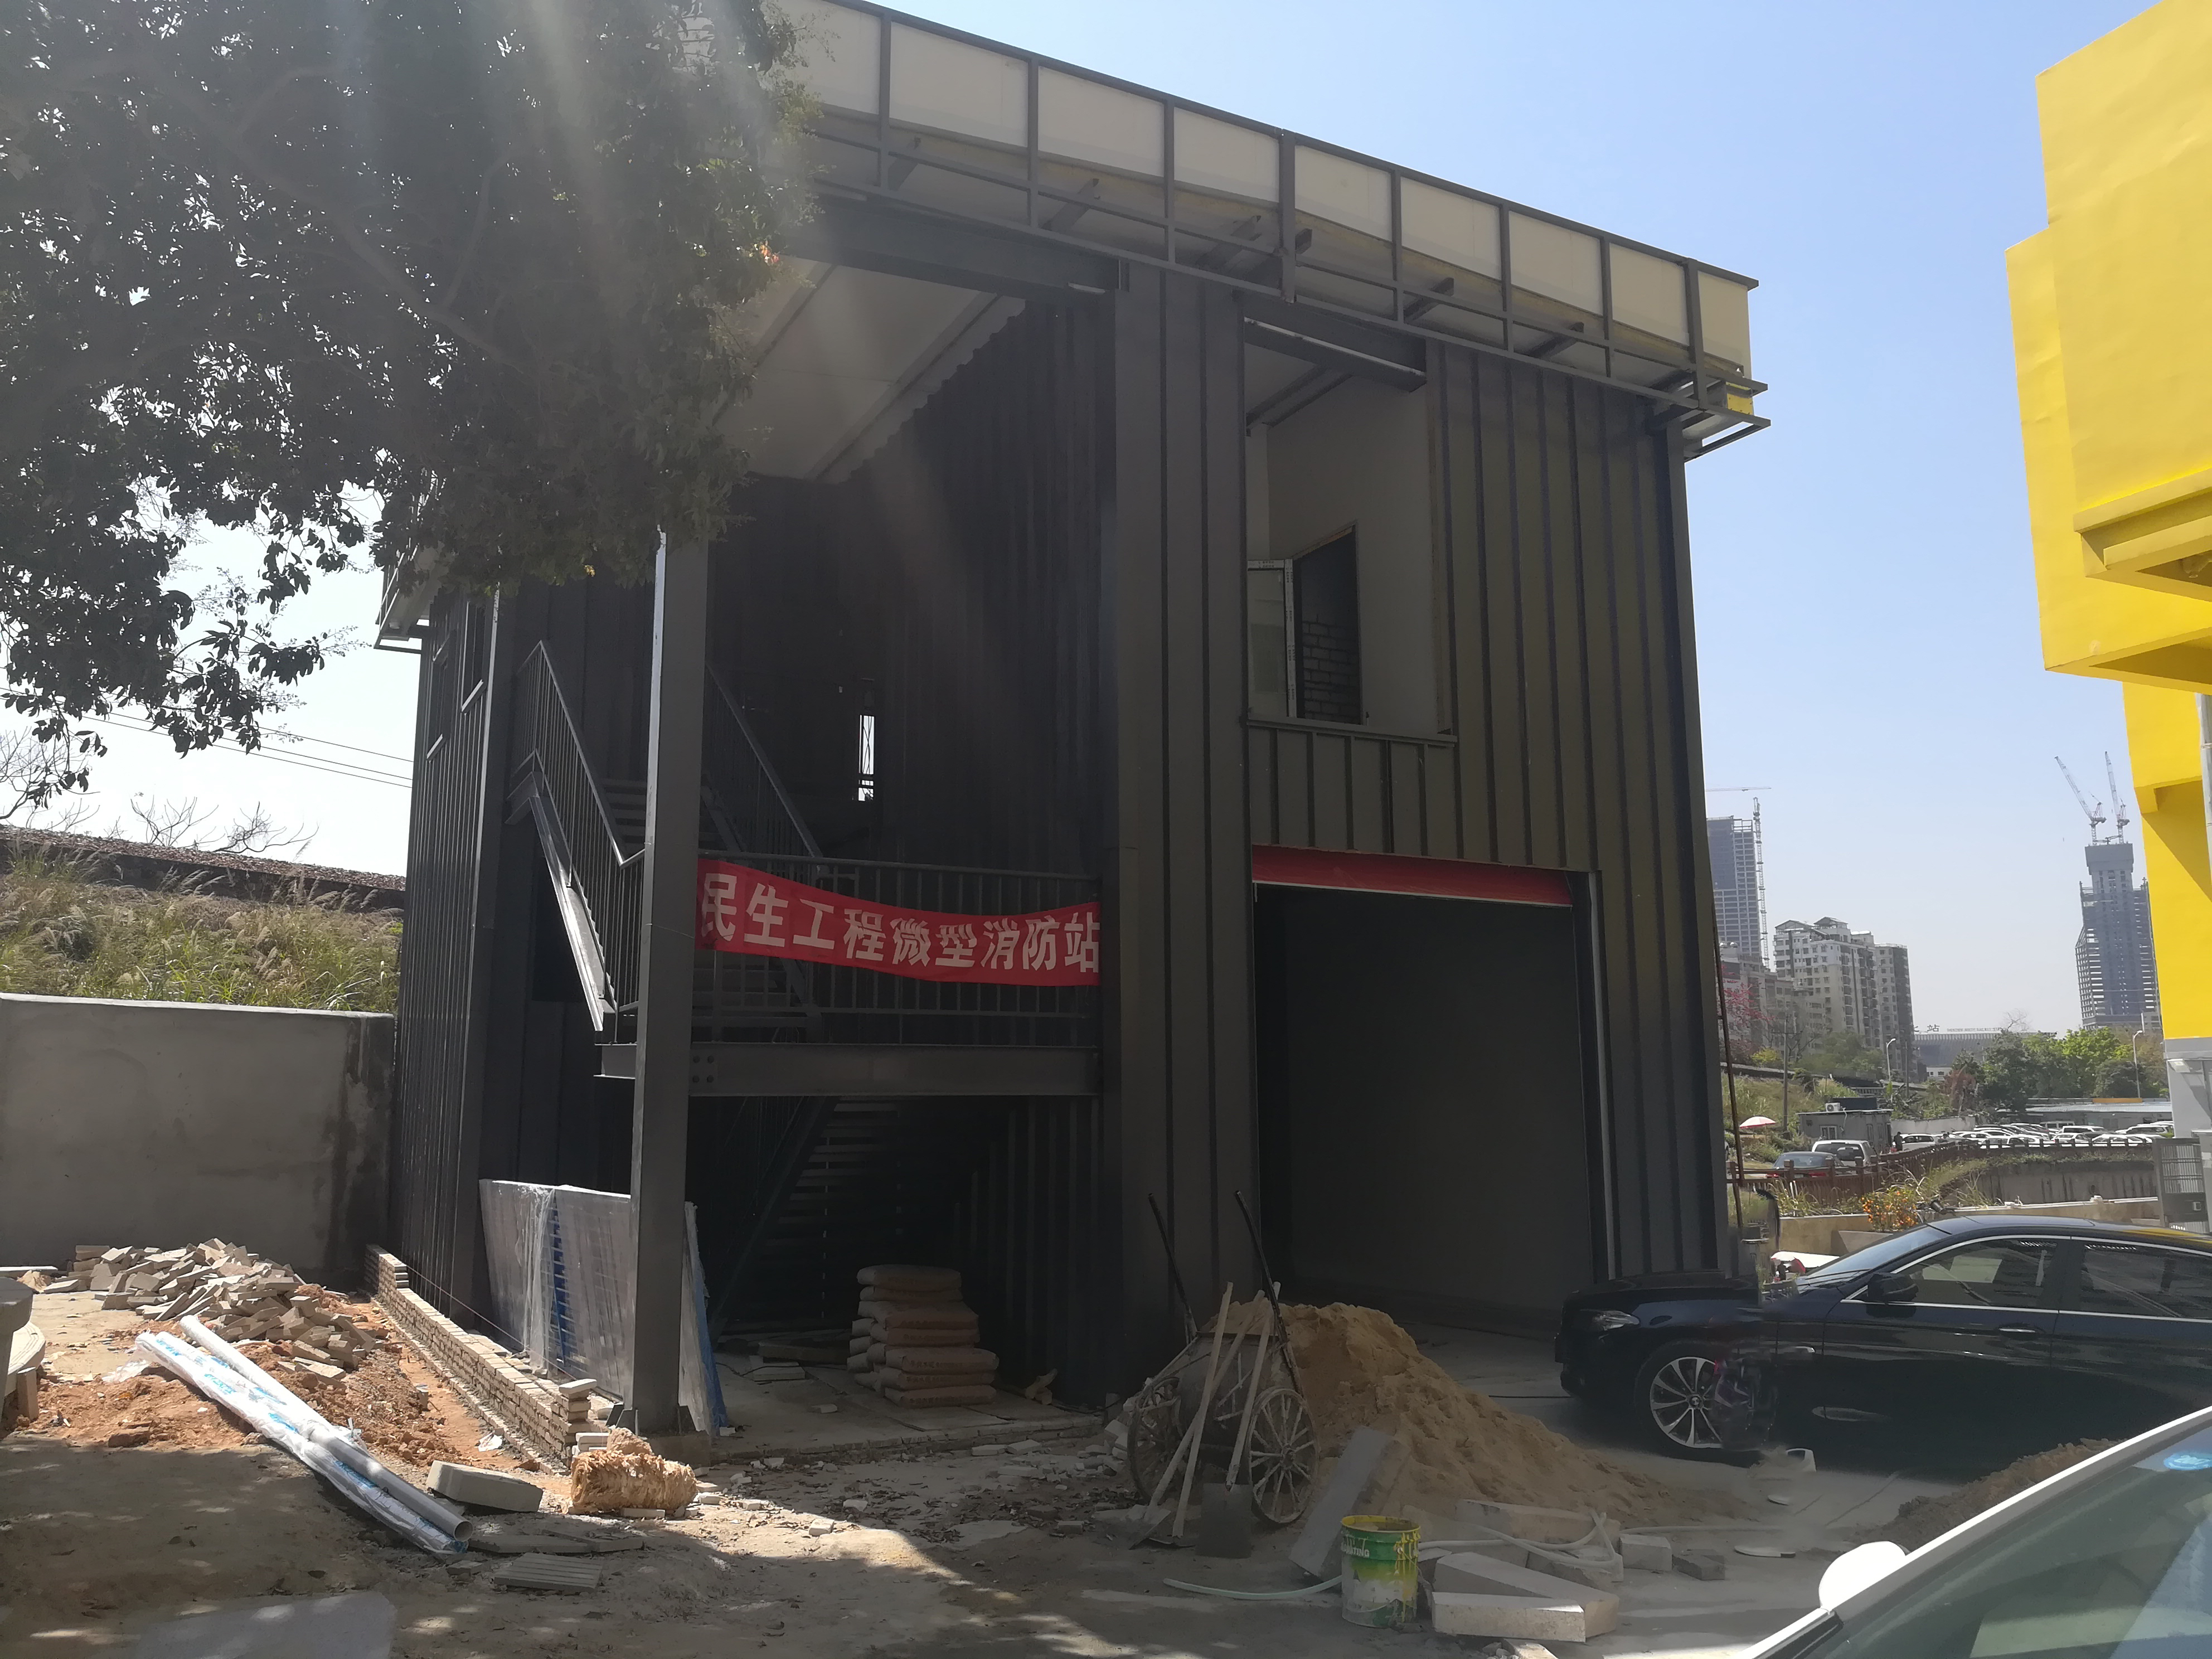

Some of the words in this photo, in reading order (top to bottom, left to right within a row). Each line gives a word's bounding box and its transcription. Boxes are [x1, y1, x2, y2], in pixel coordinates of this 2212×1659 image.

[701, 872, 1100, 973] 民生工程微型消防站
